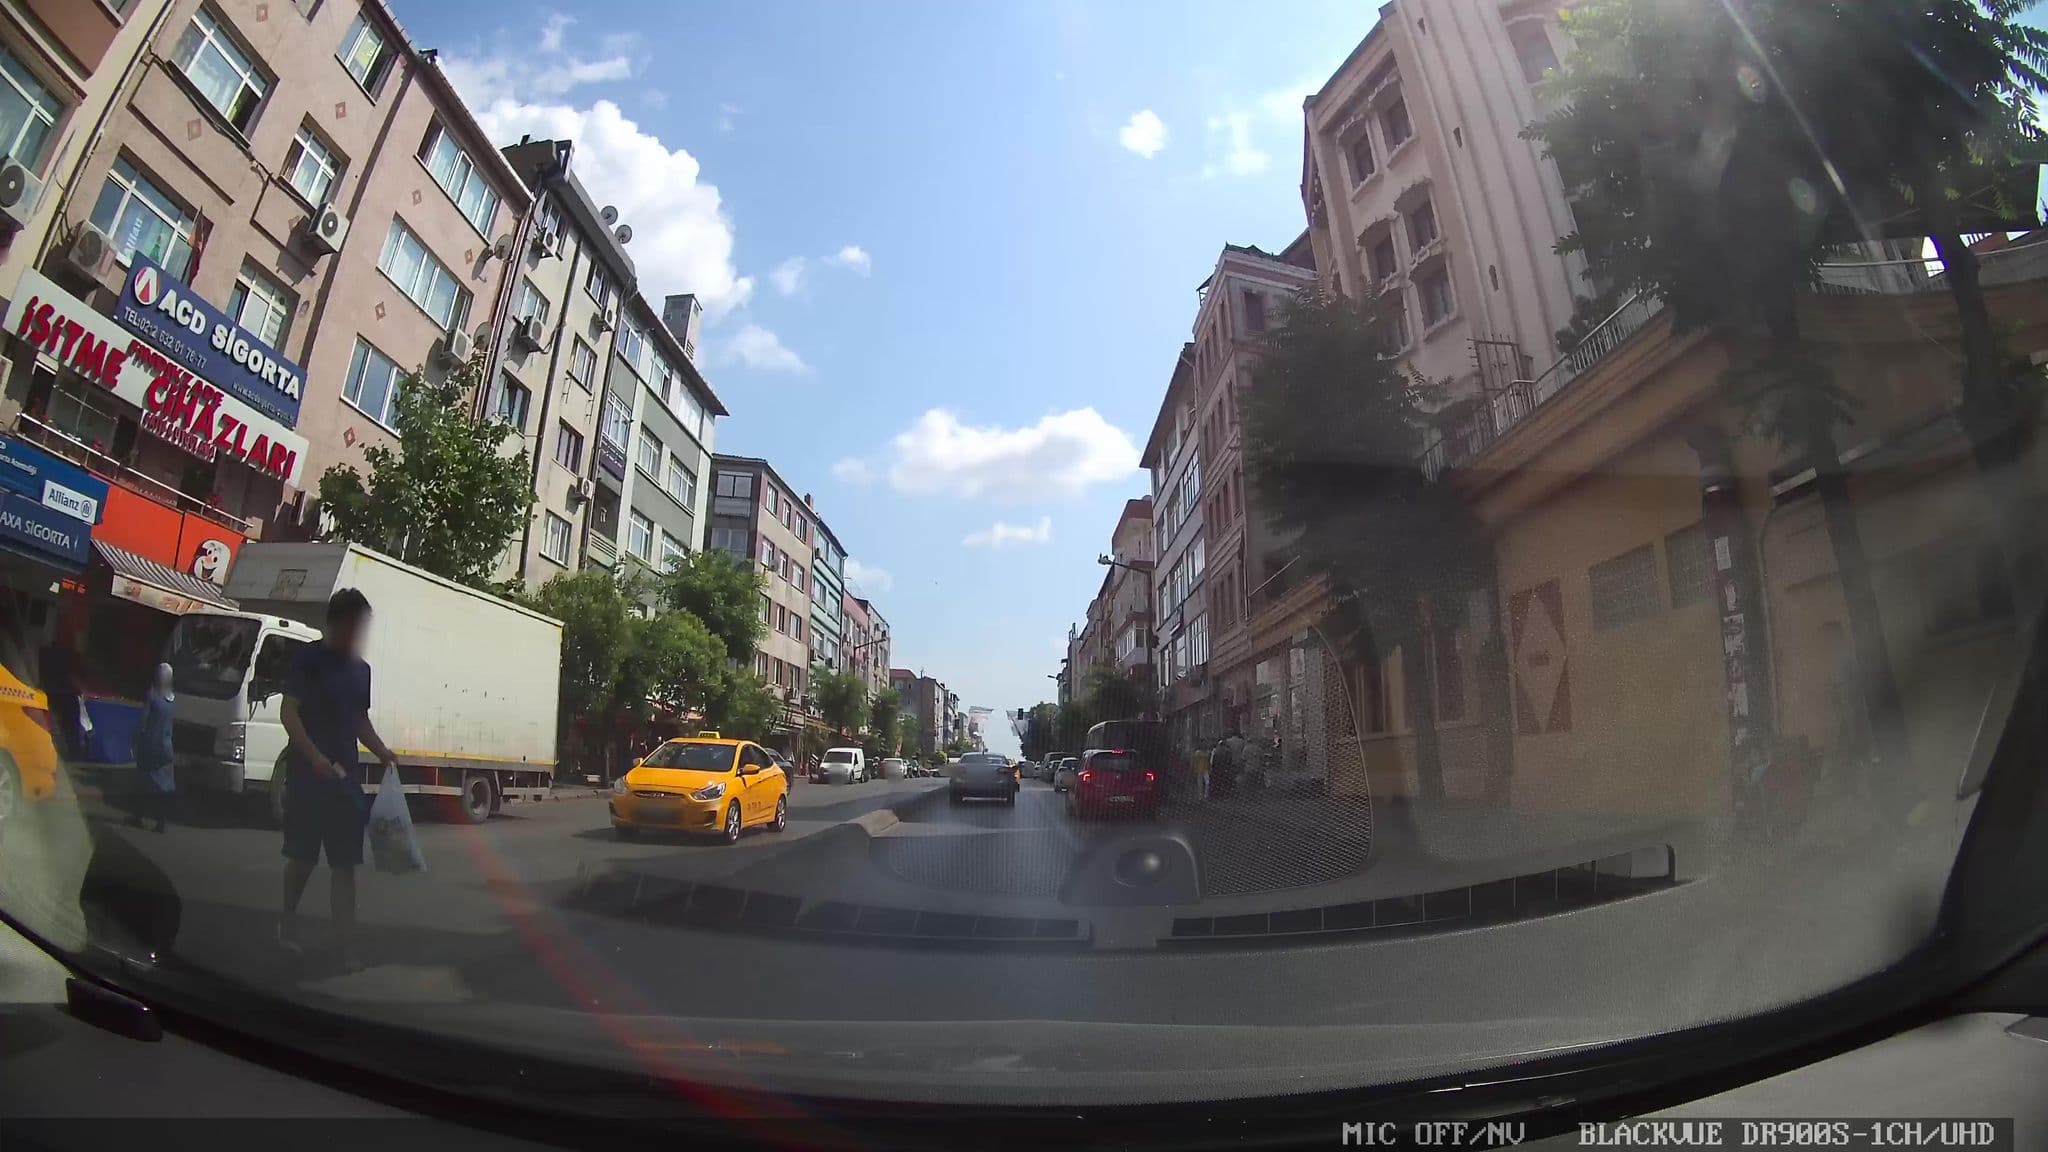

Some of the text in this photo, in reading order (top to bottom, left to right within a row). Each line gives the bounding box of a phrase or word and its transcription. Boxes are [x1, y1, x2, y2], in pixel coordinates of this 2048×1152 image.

[158, 288, 206, 335] ACD
[212, 323, 299, 401] SİGORTA
[159, 330, 174, 348] 632
[48, 488, 80, 511] Allianz
[0, 511, 70, 549] AXA SİGORTA
